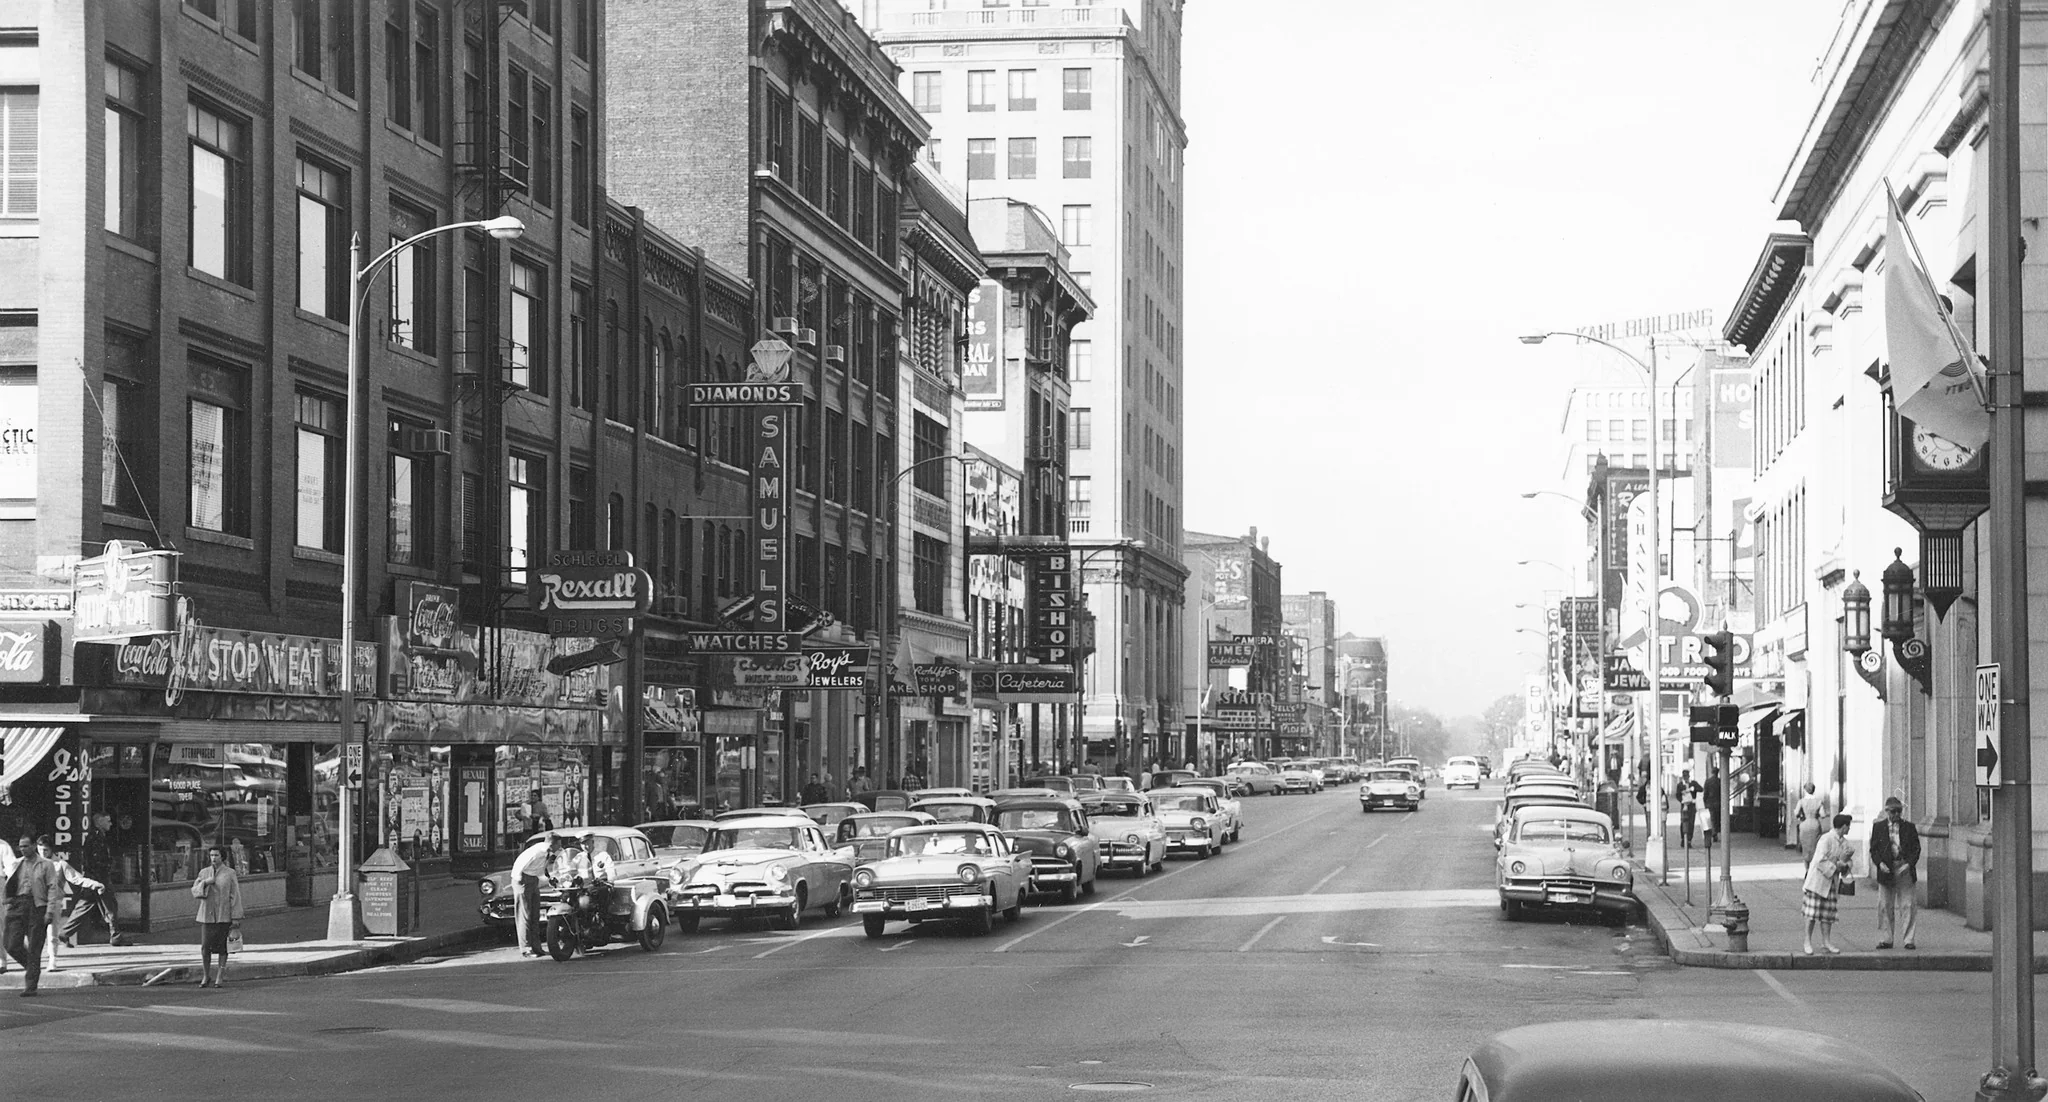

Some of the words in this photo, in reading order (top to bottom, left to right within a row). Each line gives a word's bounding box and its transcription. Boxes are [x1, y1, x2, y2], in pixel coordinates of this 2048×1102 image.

[1625, 308, 1713, 338] BUILDING
[693, 386, 791, 401] DIAMONDS
[1932, 454, 1937, 463] 7
[1943, 457, 1950, 467] 6
[1956, 454, 1963, 463] 5
[759, 414, 780, 624] SAMUELS
[553, 553, 622, 566] SCHLEGEL
[539, 571, 637, 609] Rexall
[1049, 556, 1066, 663] BISHOP
[552, 618, 625, 634] DRUGS
[692, 634, 789, 651] WATCHES
[1234, 636, 1274, 645] CAMERA
[1210, 645, 1252, 656] TIMES
[208, 638, 261, 684] STOP
[288, 646, 322, 687] EAT
[810, 650, 854, 675] Roy's
[1210, 655, 1250, 665] Cafeteria
[1278, 639, 1287, 700] GLICK'S
[1684, 667, 1709, 676] FOOD
[809, 672, 864, 687] JEWELERS
[1000, 674, 1065, 692] Cafeteria
[1978, 673, 1997, 701] ONE
[888, 684, 913, 693] AKE
[920, 684, 956, 694] SHOP
[1978, 703, 1998, 732] WAY
[1718, 731, 1737, 740] WALK
[462, 769, 486, 780] REXALL
[173, 780, 187, 789] GOOD
[186, 779, 201, 789] PLACE
[55, 784, 72, 846] STOP
[463, 837, 484, 848] SALE
